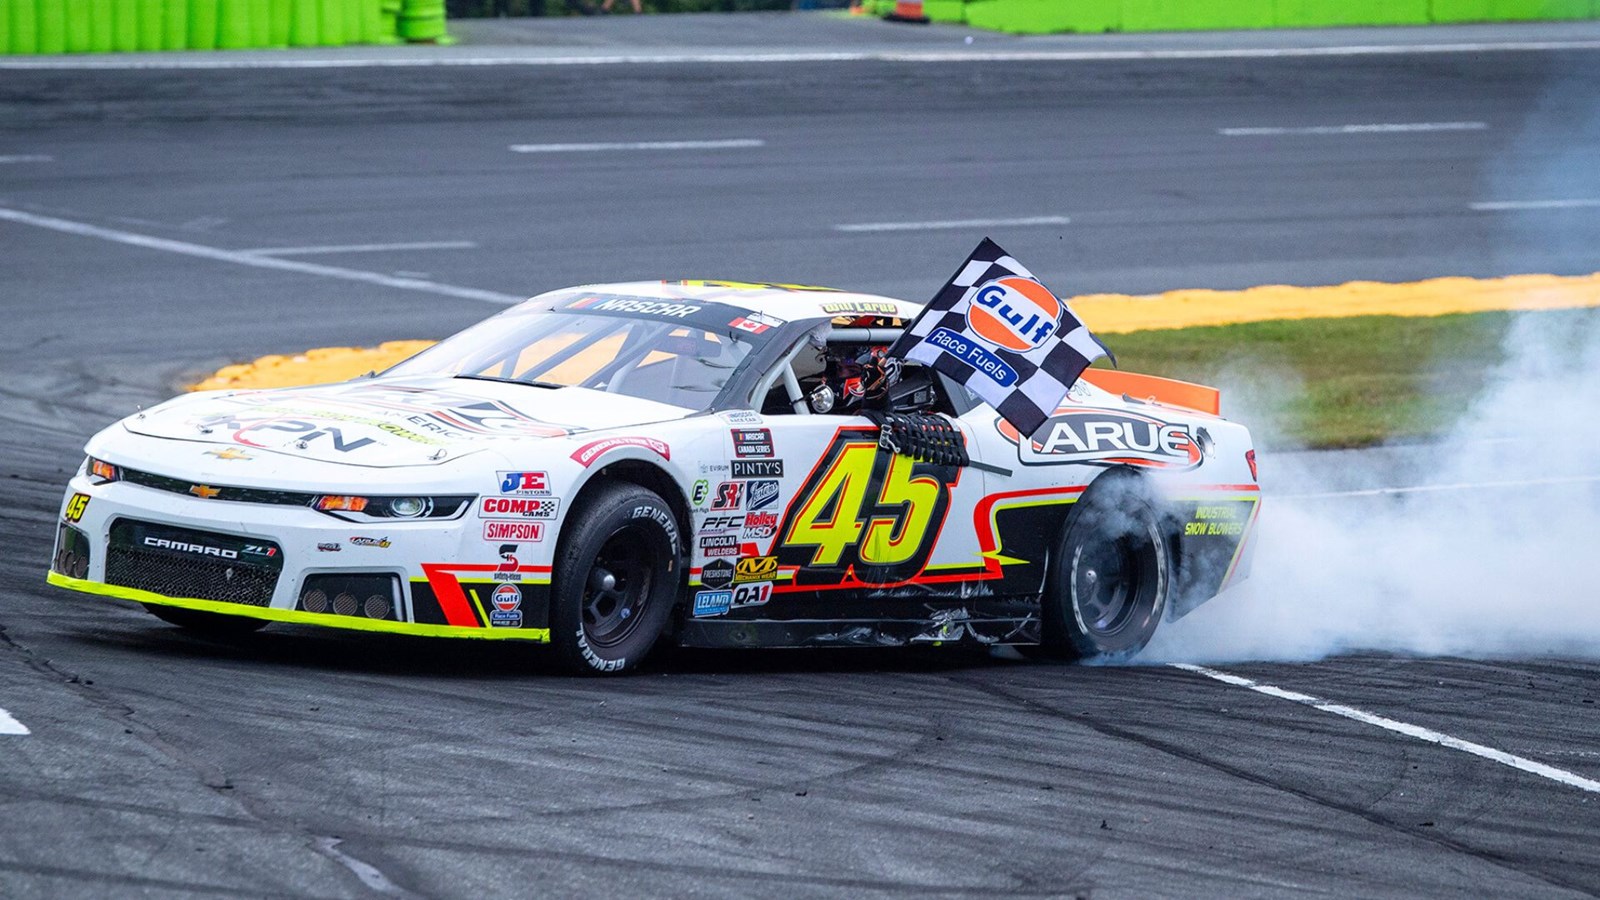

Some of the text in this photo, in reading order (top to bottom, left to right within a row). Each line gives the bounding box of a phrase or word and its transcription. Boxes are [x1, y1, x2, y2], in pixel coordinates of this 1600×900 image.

[593, 298, 702, 318] NASCAR
[976, 285, 1054, 344] Gulf
[931, 330, 1007, 381] Race Fuels
[745, 432, 765, 441] NASCAR
[737, 445, 771, 454] CANADA SERIES
[734, 462, 781, 475] PINTY'S
[502, 472, 544, 492] JE
[66, 493, 90, 522] 45
[484, 498, 540, 513] COMP
[784, 441, 941, 566] 45
[744, 512, 778, 528] Holley
[1195, 506, 1236, 519] INDUSTRIAL
[702, 516, 746, 529] PFC
[1184, 522, 1243, 535] SNOW BLOWERS
[487, 523, 540, 539] SIMPSON
[631, 506, 678, 556] GENERAL
[743, 526, 774, 539] MSD
[144, 537, 277, 559] CAMARO ZL1
[701, 537, 735, 547] LINCOLN
[707, 548, 738, 556] WELDERS
[495, 594, 518, 603] Gulf
[697, 594, 729, 609] LELAND
[734, 584, 770, 605] QA1
[575, 622, 626, 672] GENERAL
